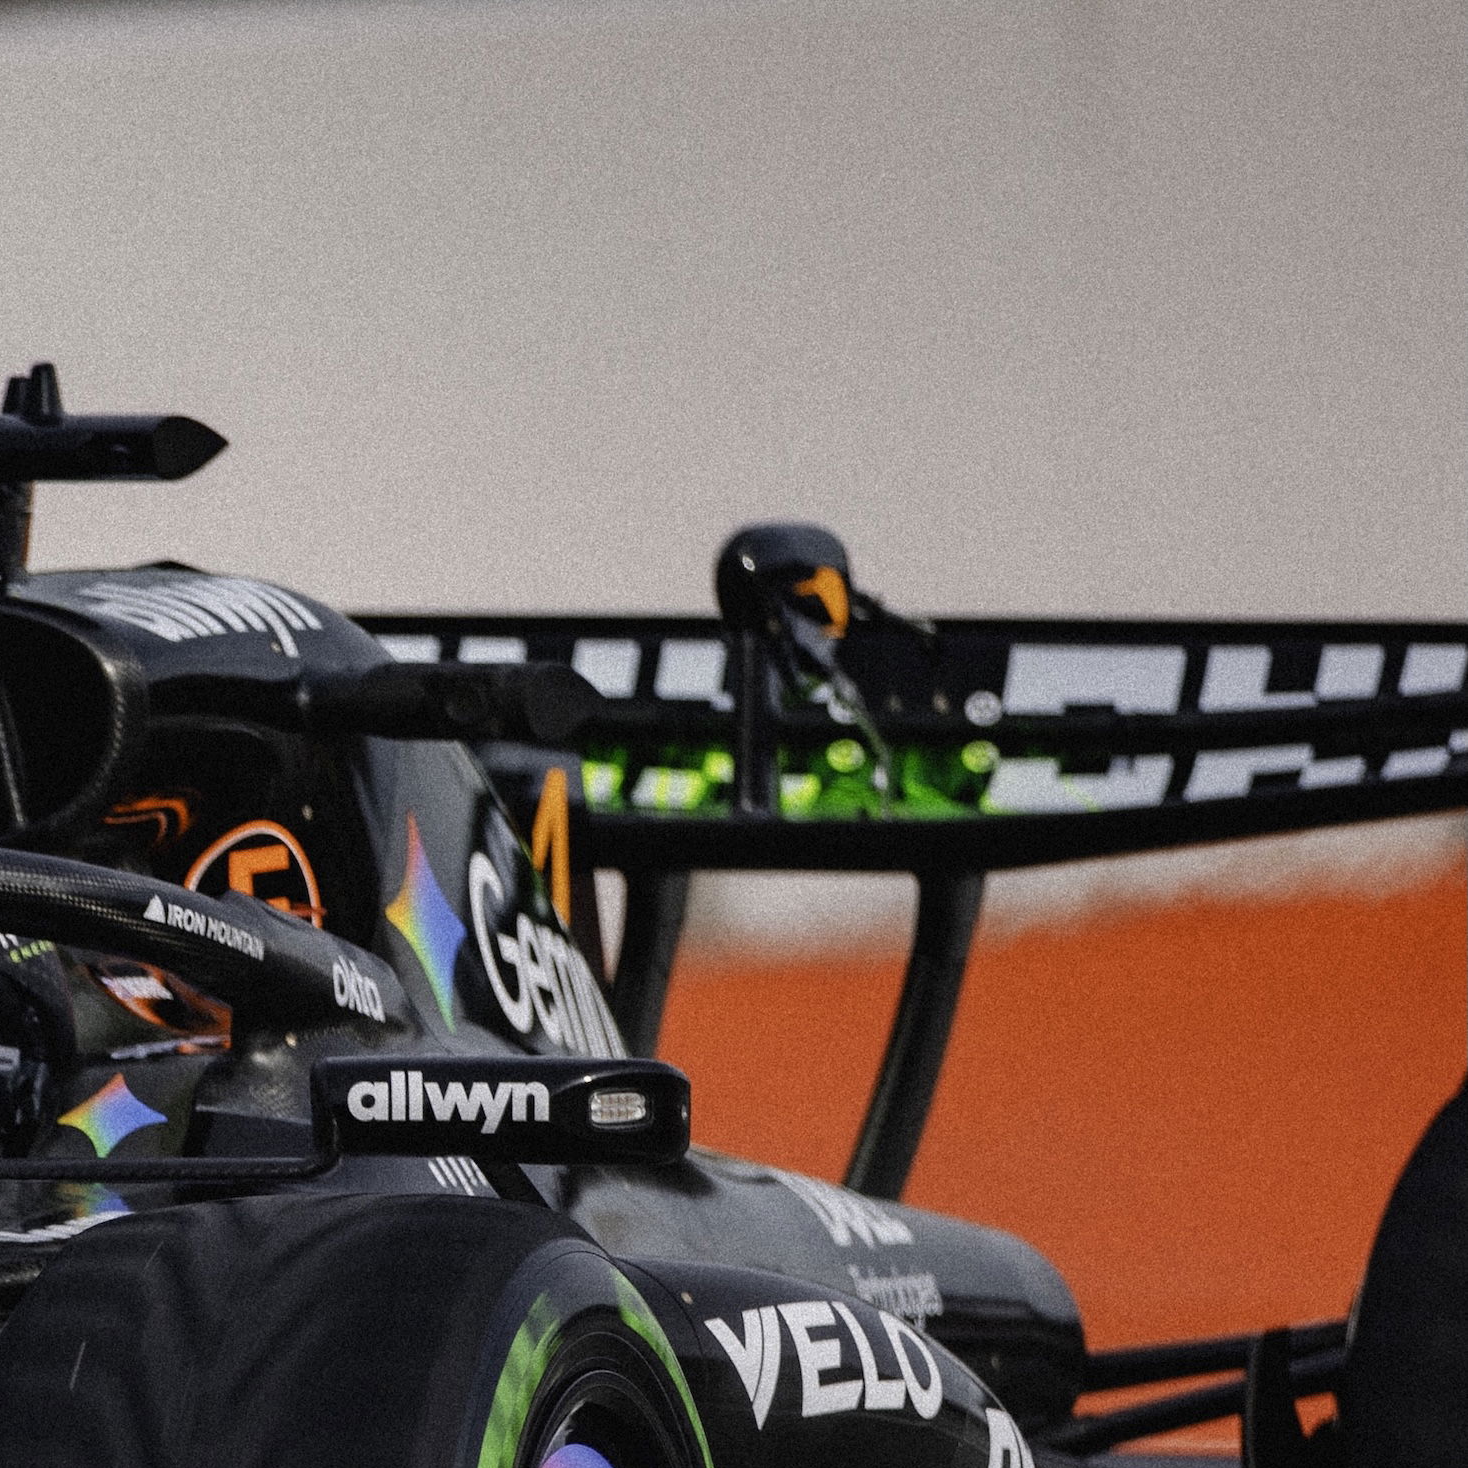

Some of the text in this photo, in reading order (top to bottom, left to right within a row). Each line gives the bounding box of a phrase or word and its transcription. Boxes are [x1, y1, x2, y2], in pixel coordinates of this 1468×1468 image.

[167, 903, 207, 938] IRON
[347, 1070, 550, 1134] allwyn
[704, 1300, 944, 1431] VELO
